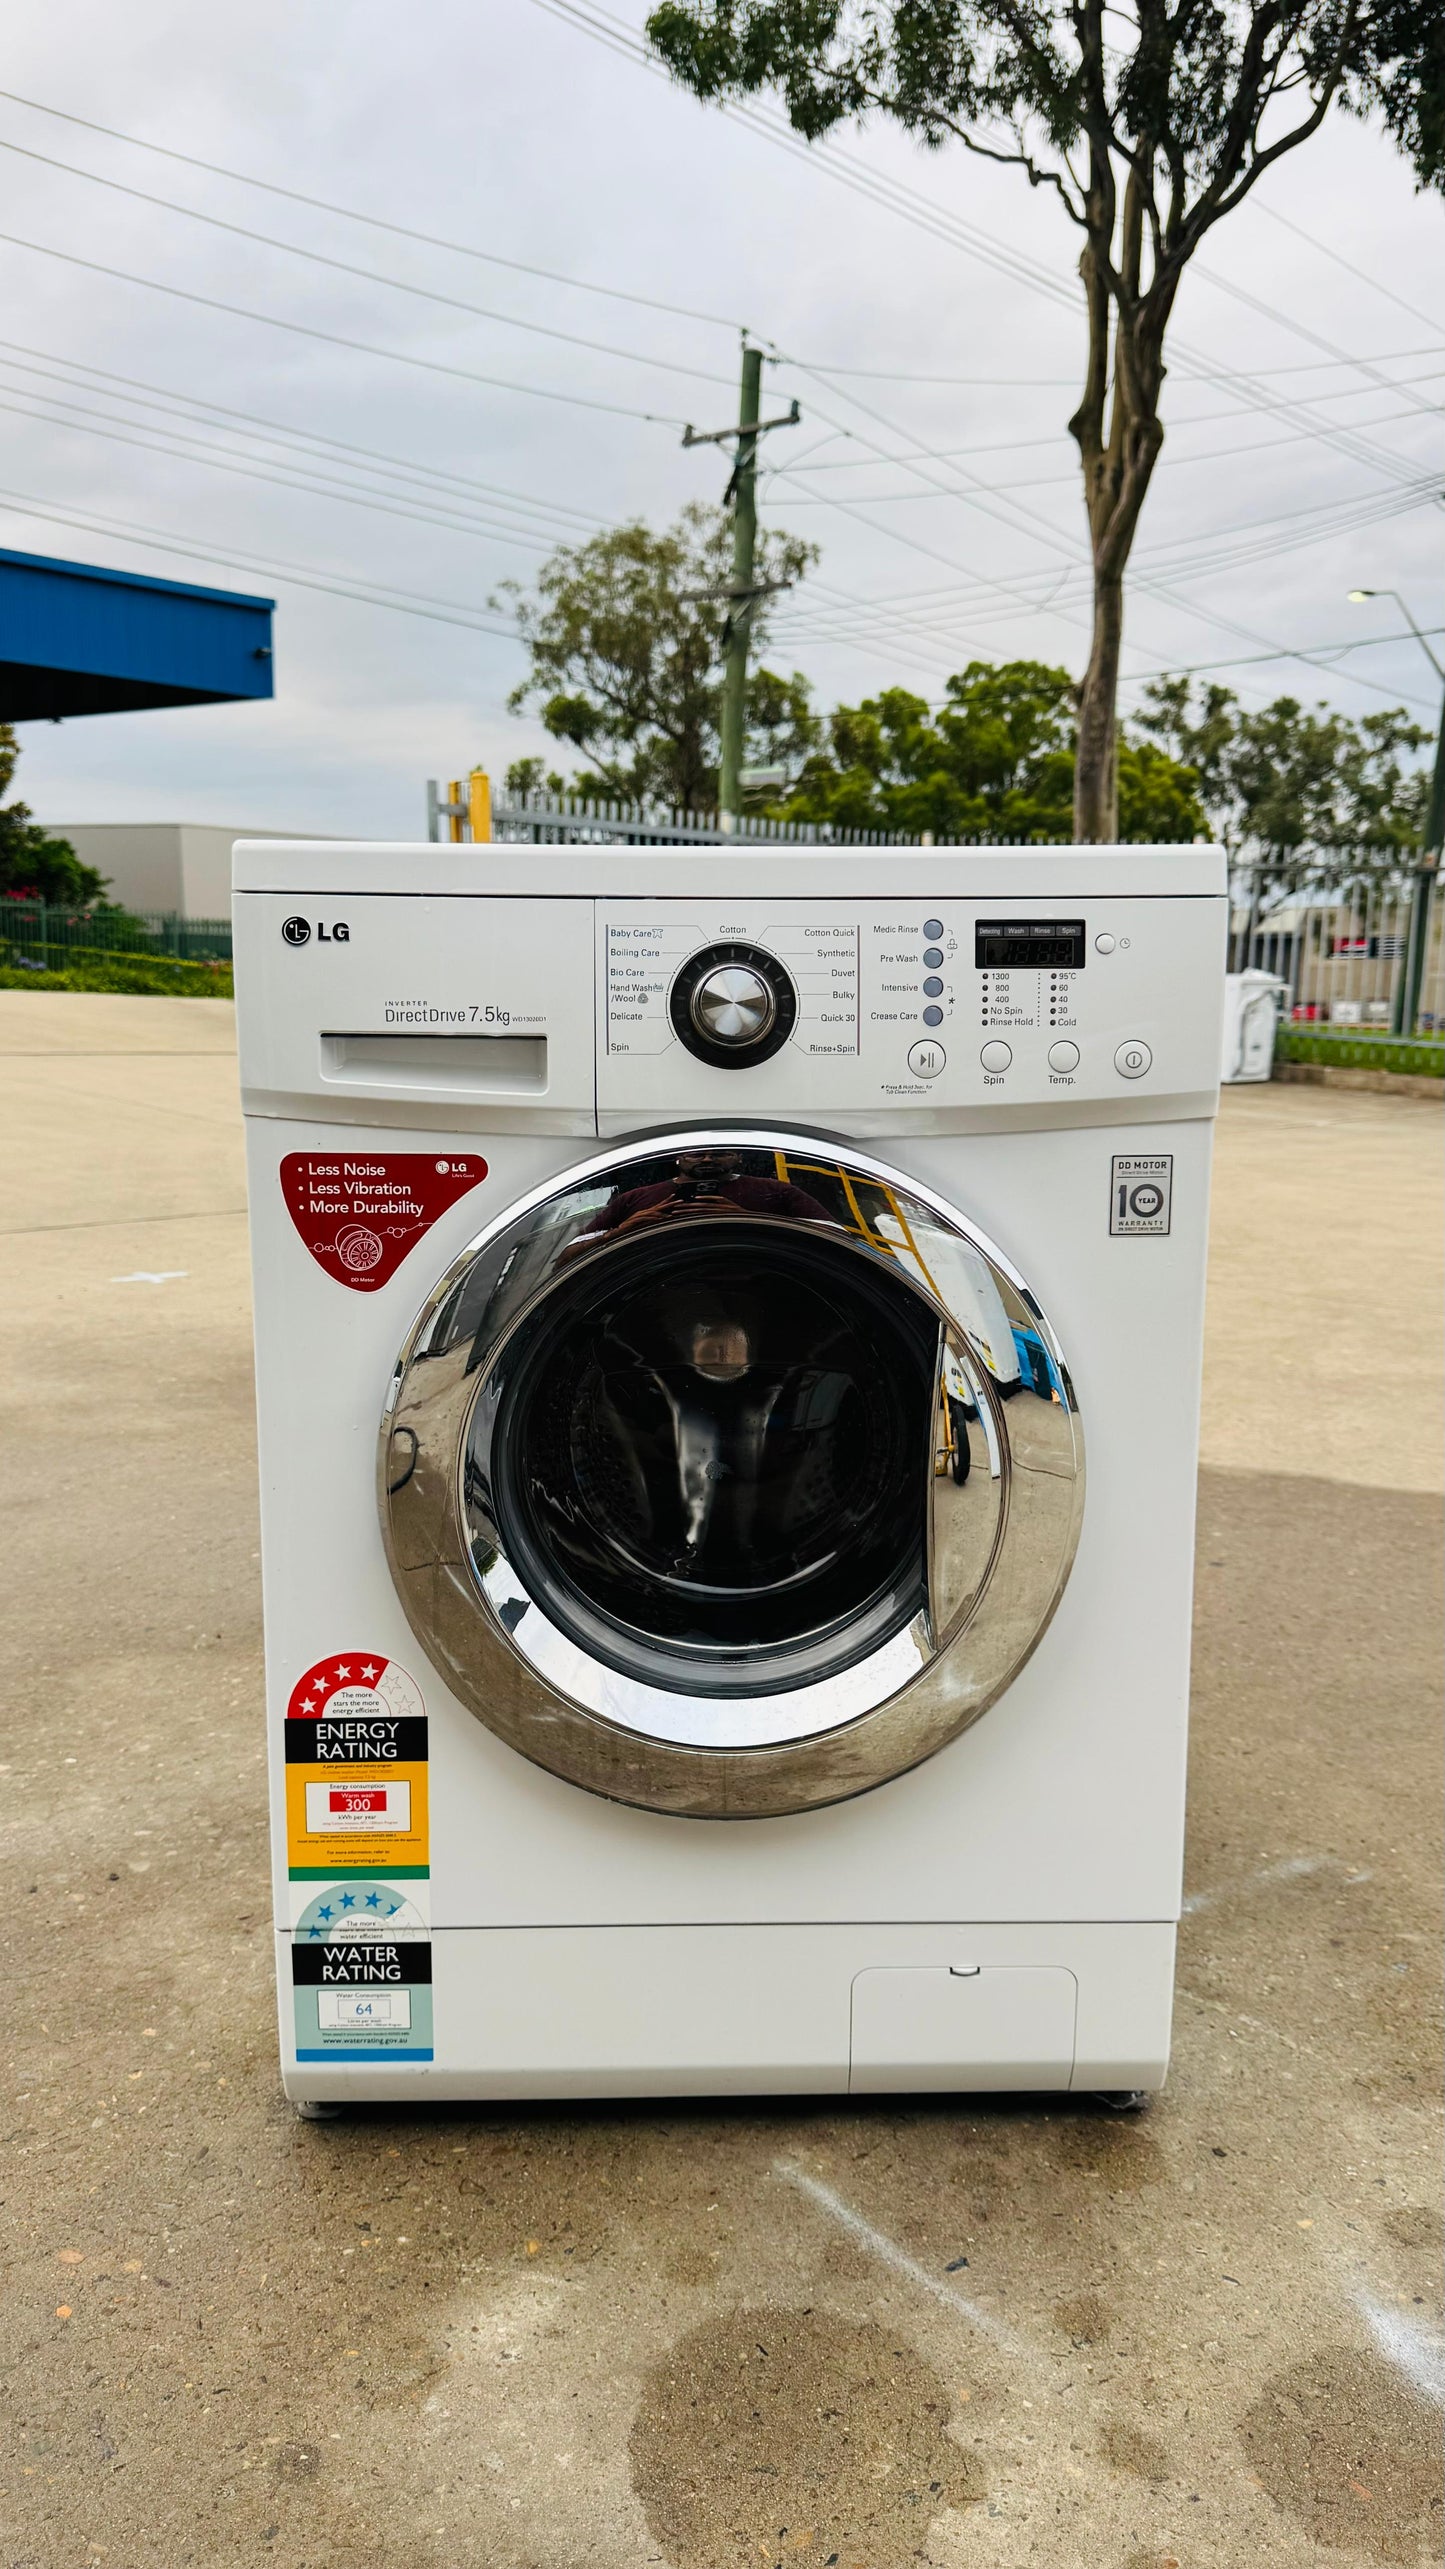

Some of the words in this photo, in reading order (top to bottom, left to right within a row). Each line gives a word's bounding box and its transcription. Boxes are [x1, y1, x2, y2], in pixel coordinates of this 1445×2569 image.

[317, 922, 350, 942] LG
[610, 929, 632, 939] Baby
[633, 929, 652, 938] Care
[719, 925, 747, 934] Cotton
[804, 929, 832, 937] Cotton
[833, 929, 855, 938] Quick
[873, 925, 896, 934] Medic
[898, 925, 918, 934] Rinse
[1008, 927, 1024, 935] Wash
[1034, 927, 1051, 935] Rinse
[1062, 927, 1076, 936] Spin
[610, 948, 639, 958] Boiling
[641, 949, 660, 957] Care
[817, 949, 855, 959] Synthetic
[880, 954, 894, 963] Pre
[896, 954, 918, 963] Wash
[610, 968, 624, 977] Bio
[626, 969, 645, 977] Care
[831, 969, 855, 977] Duvet
[610, 984, 630, 992] Hand
[631, 984, 653, 992] Wash
[881, 983, 918, 992] Intensive
[995, 984, 1010, 992] 800
[1058, 984, 1069, 992] 60
[611, 993, 636, 1003] /Wool
[832, 990, 855, 1001] Bulky
[468, 1006, 510, 1026] 7.5kg
[610, 1012, 643, 1020] Delicate
[871, 1012, 898, 1020] Crease
[900, 1012, 918, 1020] Care
[990, 1007, 1002, 1015] No
[1004, 1007, 1023, 1017] Spin
[1057, 1007, 1068, 1015] 30
[821, 1014, 844, 1024] Quick
[845, 1014, 855, 1022] 30
[990, 1018, 1013, 1026] Rinse
[1014, 1018, 1034, 1026] Hold
[1057, 1018, 1077, 1026] Cold
[611, 1042, 629, 1052] Spin
[810, 1044, 855, 1054] Rinse+Spin
[983, 1075, 1005, 1086] Spin
[1048, 1075, 1077, 1086] Temp.
[308, 1162, 340, 1176] Less
[343, 1162, 386, 1176] Noise
[451, 1163, 467, 1173] LG
[1118, 1161, 1131, 1170] DD
[1134, 1161, 1167, 1169] MOTOR
[309, 1181, 340, 1195] Less
[343, 1181, 412, 1196] Vibration
[1118, 1183, 1164, 1218] 10
[309, 1200, 349, 1214] More
[353, 1200, 424, 1218] Durability
[332, 1708, 354, 1716] energy
[316, 1722, 400, 1740] ENERGY
[316, 1742, 398, 1759] RATING
[345, 1799, 371, 1811] 300
[323, 1946, 399, 1962] WATER
[322, 1965, 402, 1981] RATING
[355, 2003, 373, 2015] 64
[323, 2037, 408, 2046] www.waterrating.gov.au
